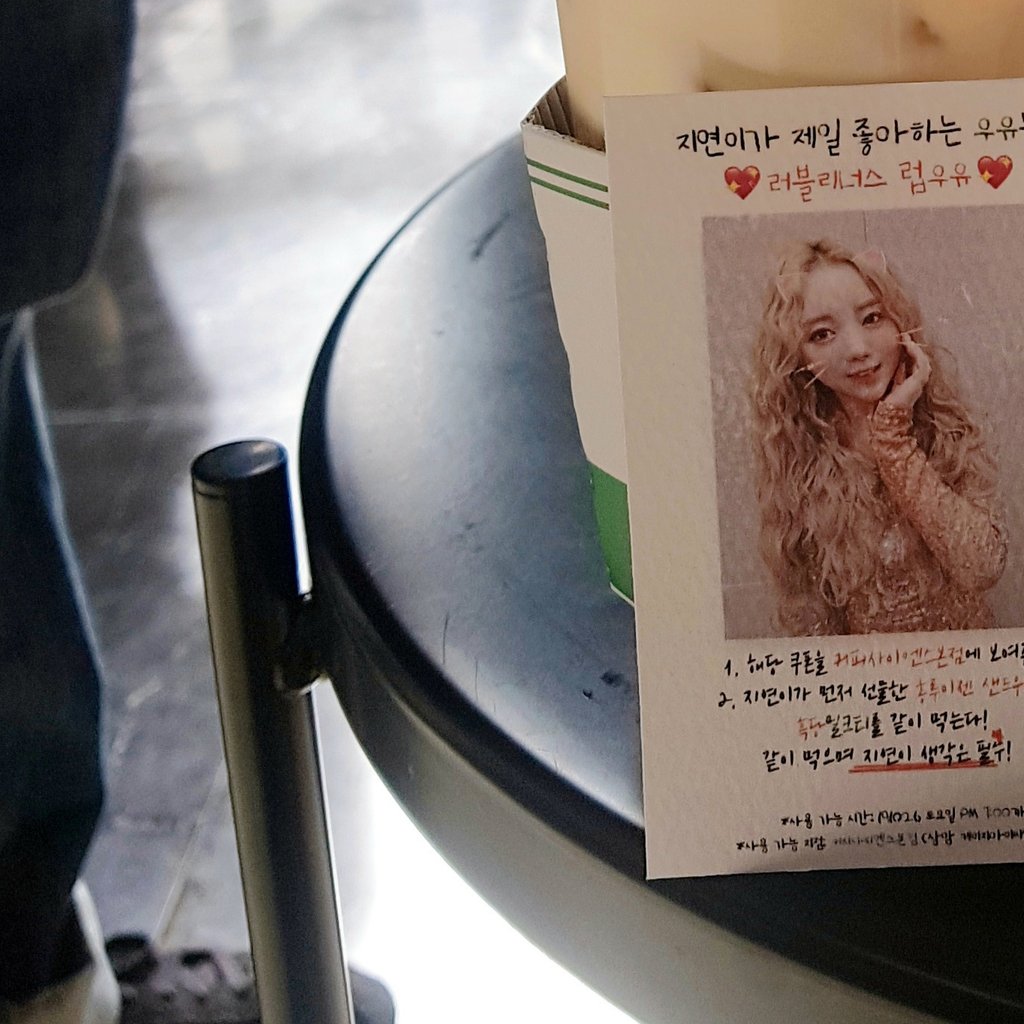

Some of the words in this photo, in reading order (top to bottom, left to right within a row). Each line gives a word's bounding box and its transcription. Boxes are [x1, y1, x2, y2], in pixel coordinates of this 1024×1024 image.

[676, 125, 780, 158] 지연이가
[791, 118, 841, 156] 제일
[851, 116, 962, 156] 좋아하는
[767, 164, 888, 203] 러블리너스
[898, 160, 972, 196] 럽우유
[723, 658, 739, 677] 1.
[747, 652, 783, 676] 해당
[790, 649, 828, 676] 쿠폰을
[717, 691, 736, 710] 2.
[743, 685, 812, 707] 지연이가
[819, 684, 853, 703] 먼저
[861, 679, 908, 706] 선물한
[890, 711, 922, 734] 같이
[930, 709, 988, 734] 먹는다!
[762, 750, 795, 773] 같이
[803, 747, 854, 770] 먹으며
[863, 744, 912, 765] 지연이
[920, 742, 972, 765] 생각은
[819, 812, 843, 827] 가능
[774, 836, 799, 852] 가능
